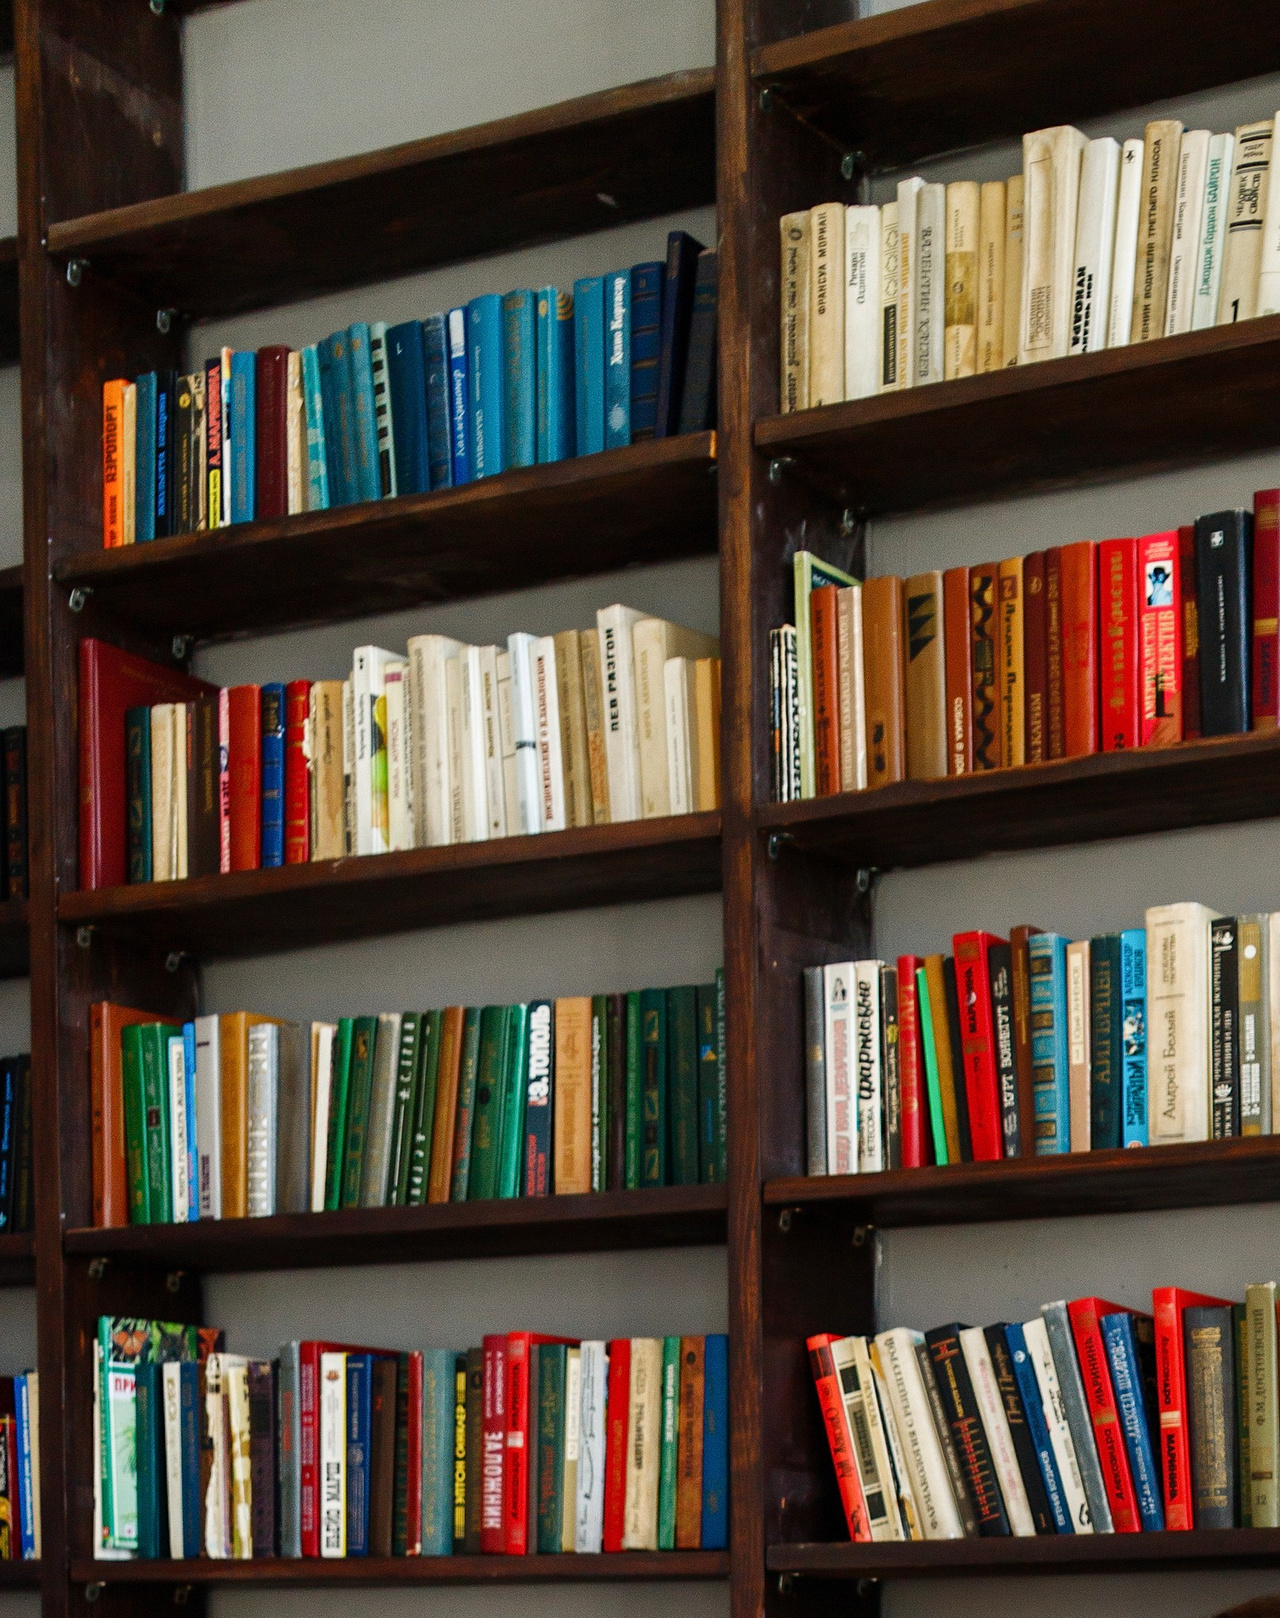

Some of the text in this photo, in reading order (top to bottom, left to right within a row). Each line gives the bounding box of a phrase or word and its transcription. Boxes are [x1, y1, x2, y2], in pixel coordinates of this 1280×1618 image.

[1199, 246, 1214, 296] Джордж
[1207, 158, 1222, 203] БАЙРОН
[817, 264, 827, 314] ФРАНСУА
[605, 628, 620, 732] ЛЕВ РАЗГОН
[1158, 610, 1176, 692] ДЕТЕКТИВ
[529, 1005, 550, 1076] ТОПОЛЬ
[998, 1005, 1015, 1108] КУРТ ВОННЕГУТ
[1163, 1010, 1179, 1120] Андрей Белый
